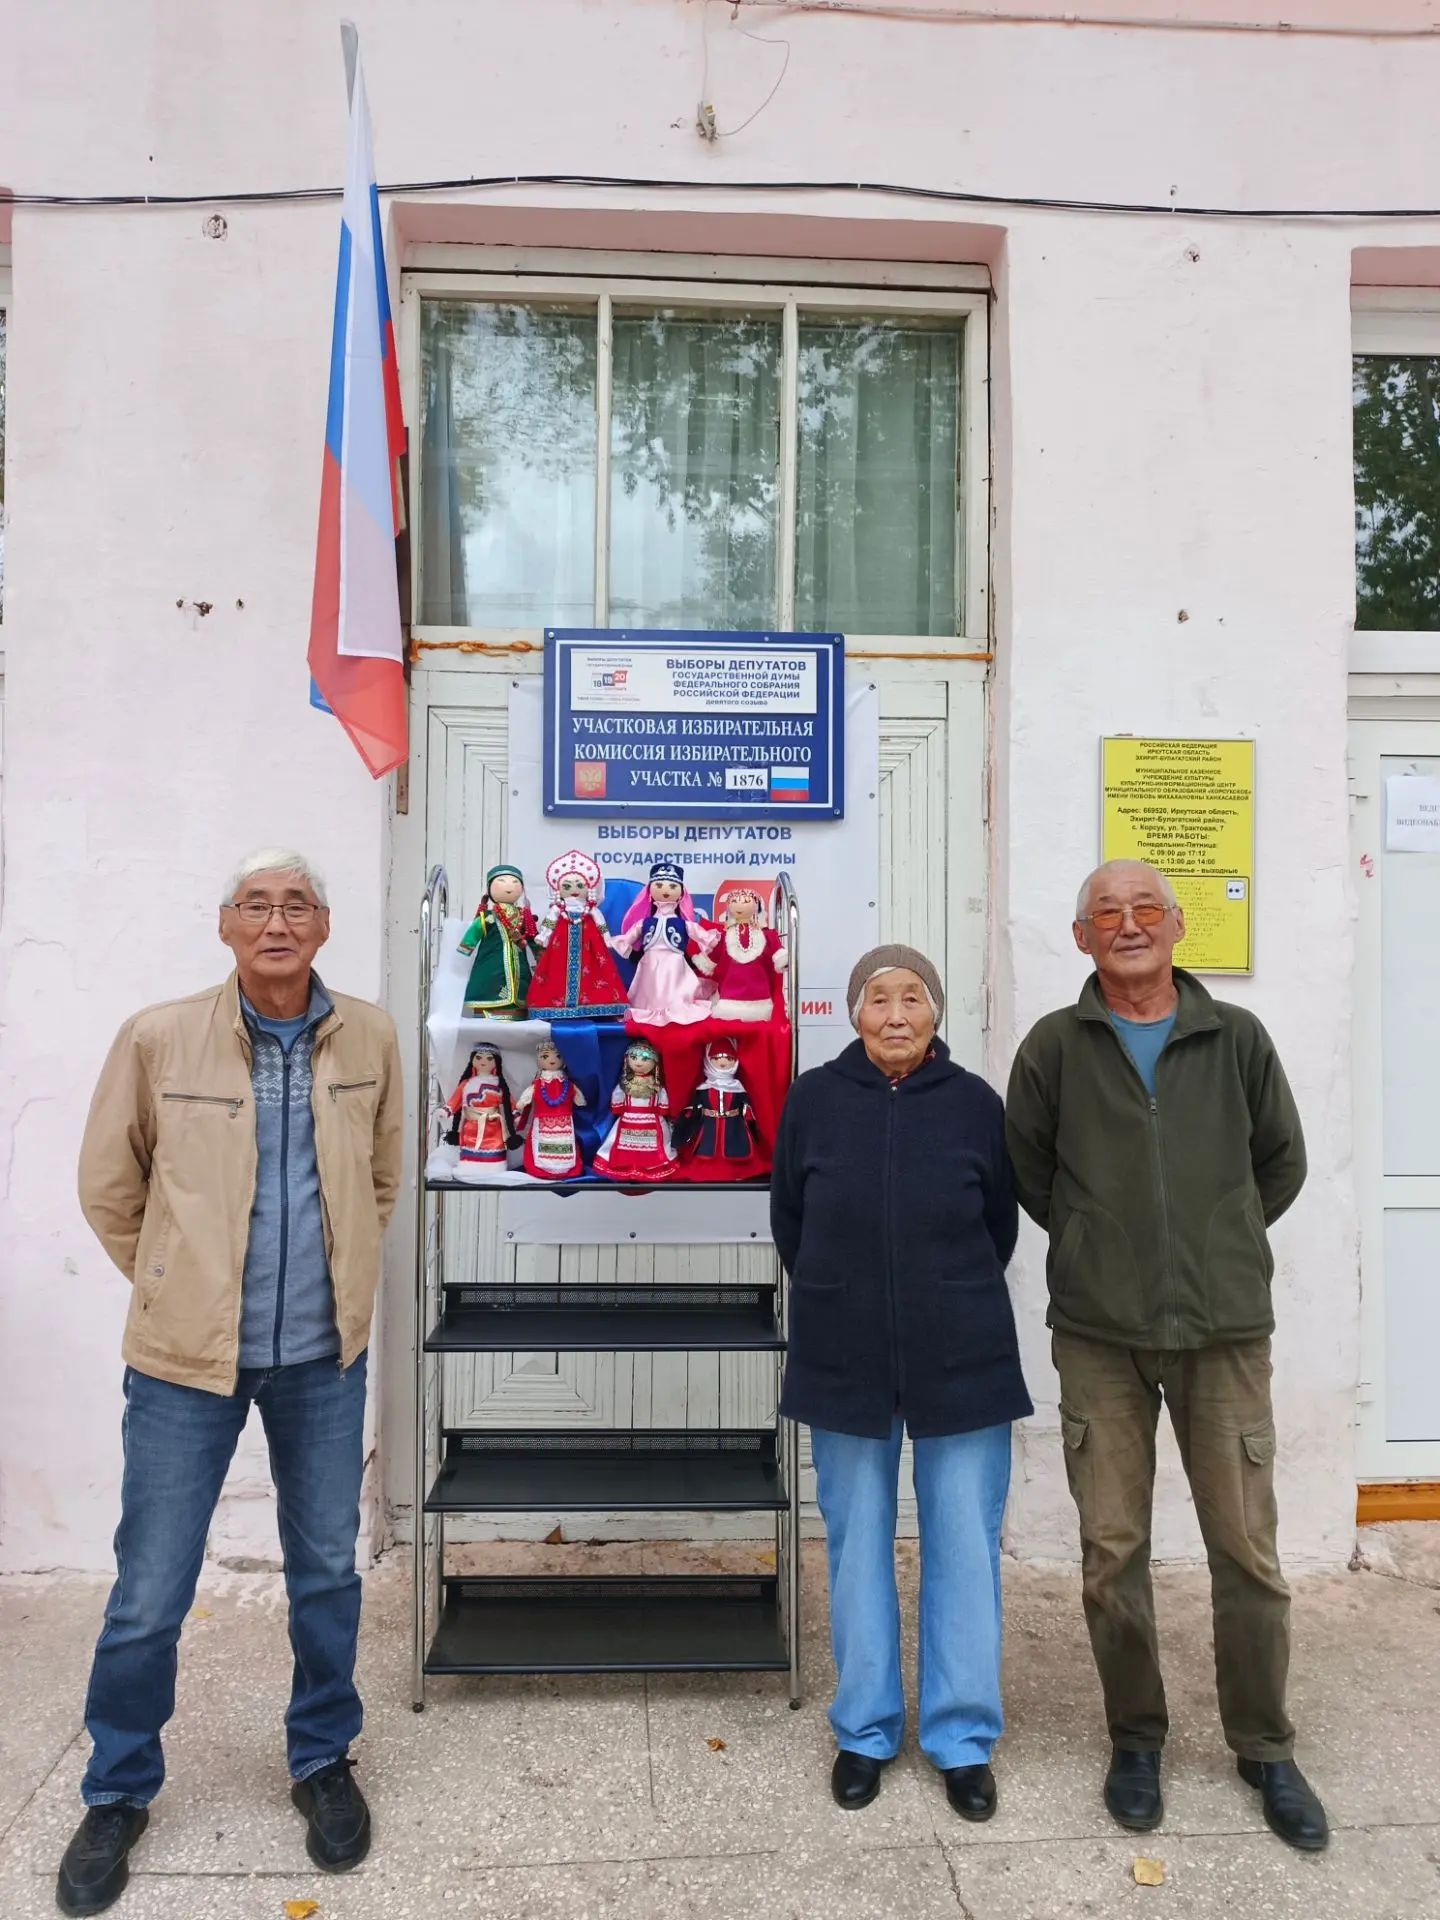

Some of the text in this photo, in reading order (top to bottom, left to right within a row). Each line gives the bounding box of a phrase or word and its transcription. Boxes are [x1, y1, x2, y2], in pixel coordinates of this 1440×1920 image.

[666, 659, 806, 671] ВЫБОРЫ ДЕПУТАТОВ
[614, 673, 625, 681] 20
[672, 671, 768, 680] ГОСУДАРСТВЕННОЙ
[673, 680, 800, 689] ФЕДЕРАЛЬНОГО СОБРАНИЯ
[673, 689, 799, 699] РОССИЙСКОЙ ФЕДЕРАЦИИ
[573, 718, 813, 737] УЧАСТКОВАЯ ИЗБИРАТЕЛЬНАЯ
[575, 743, 811, 762] КОМИССИЯ ИЗБИРАТЕЛЬНОГО
[630, 770, 763, 787] УЧАСТКА № 1876
[598, 825, 791, 842] ВЫБОРЫ ДЕПУТАТОВ
[594, 851, 795, 866] ГОСУДАРСТВЕННОЙ ДУМЫ
[801, 1001, 832, 1015] ИИ!
